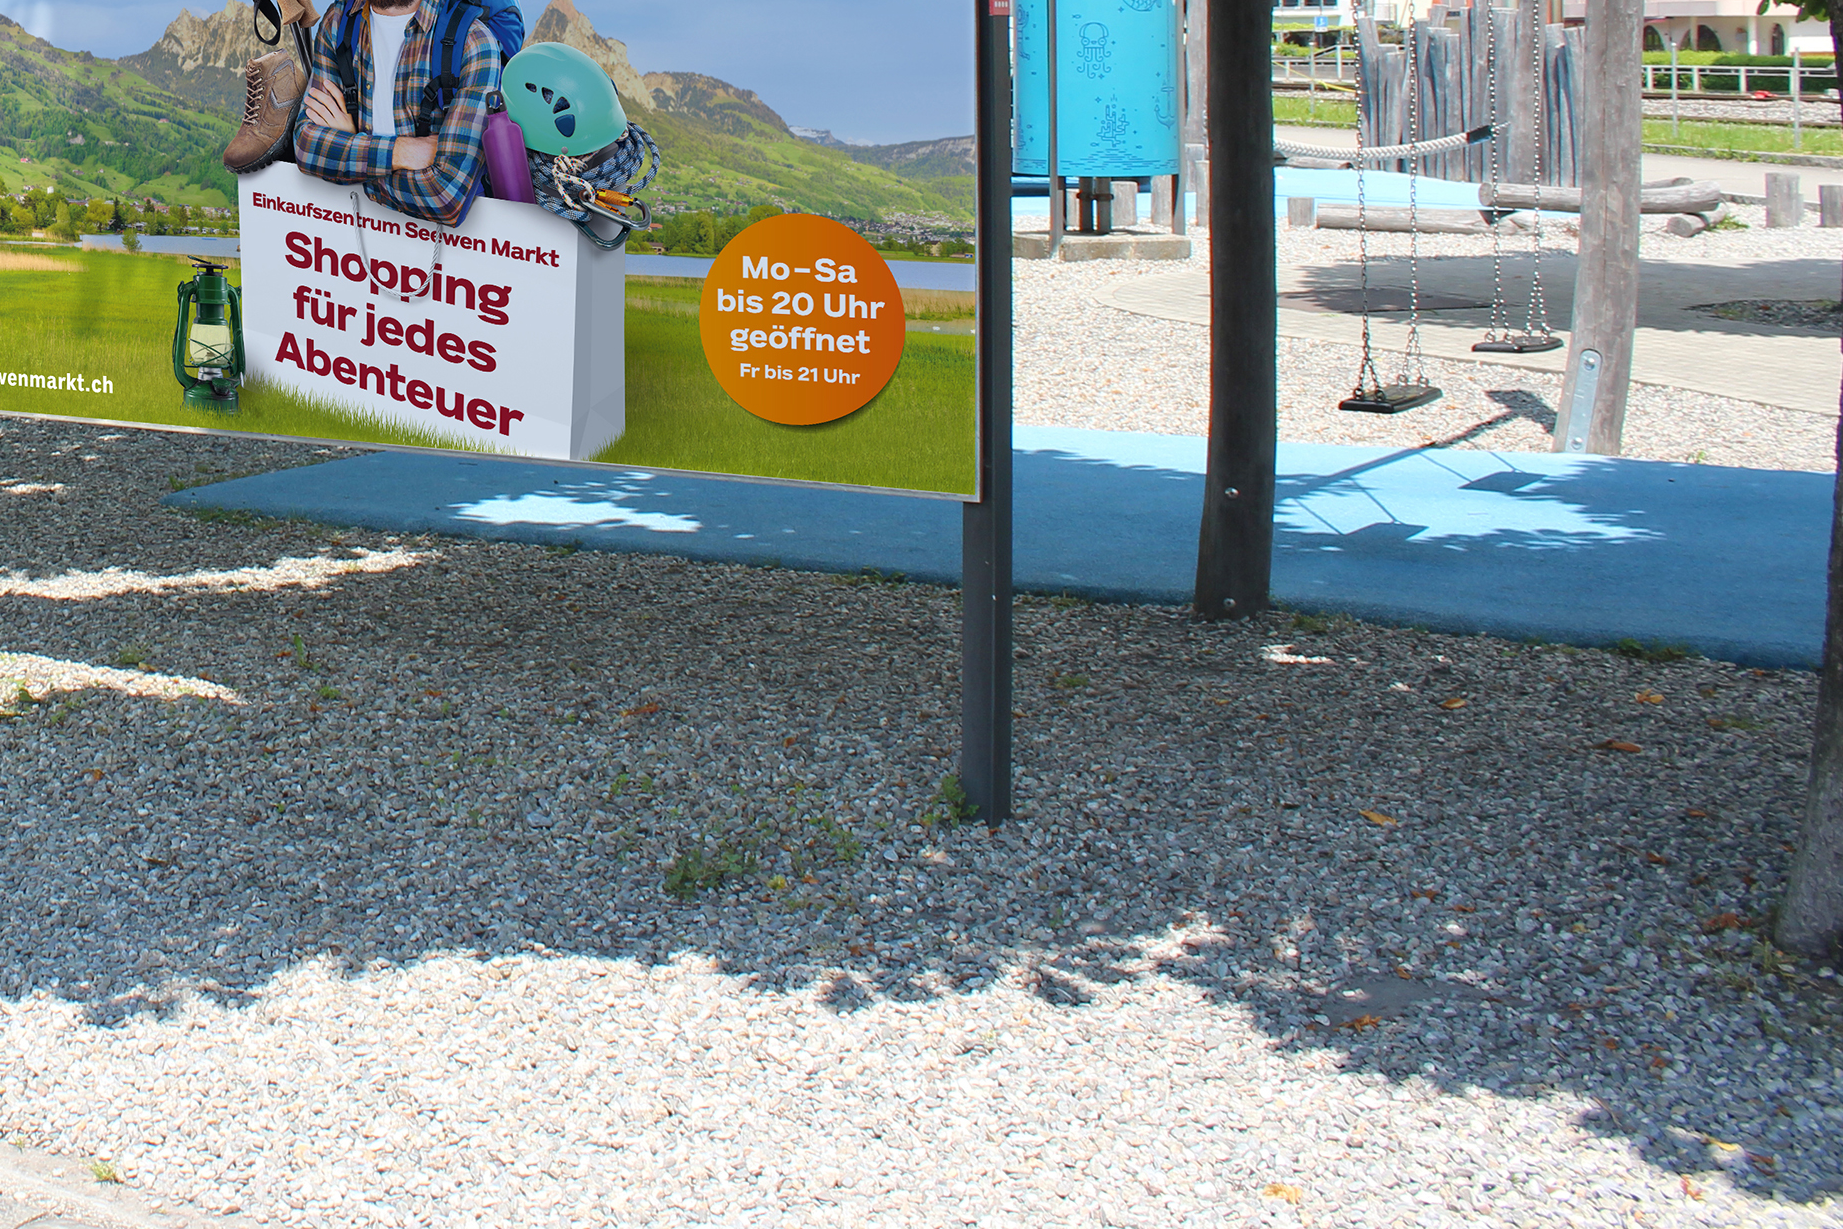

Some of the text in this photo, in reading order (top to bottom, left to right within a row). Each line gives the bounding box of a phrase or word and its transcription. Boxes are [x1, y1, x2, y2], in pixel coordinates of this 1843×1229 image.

[252, 192, 560, 267] Einkaufszentrum Seewen Markt
[285, 231, 512, 325] Shopping
[717, 288, 885, 319] bis 20 Uhr
[293, 285, 497, 373] für jedes
[730, 325, 871, 354] geöffnet
[275, 331, 525, 436] Abenteuer
[740, 363, 861, 384] Fr bis 21 Uhr
